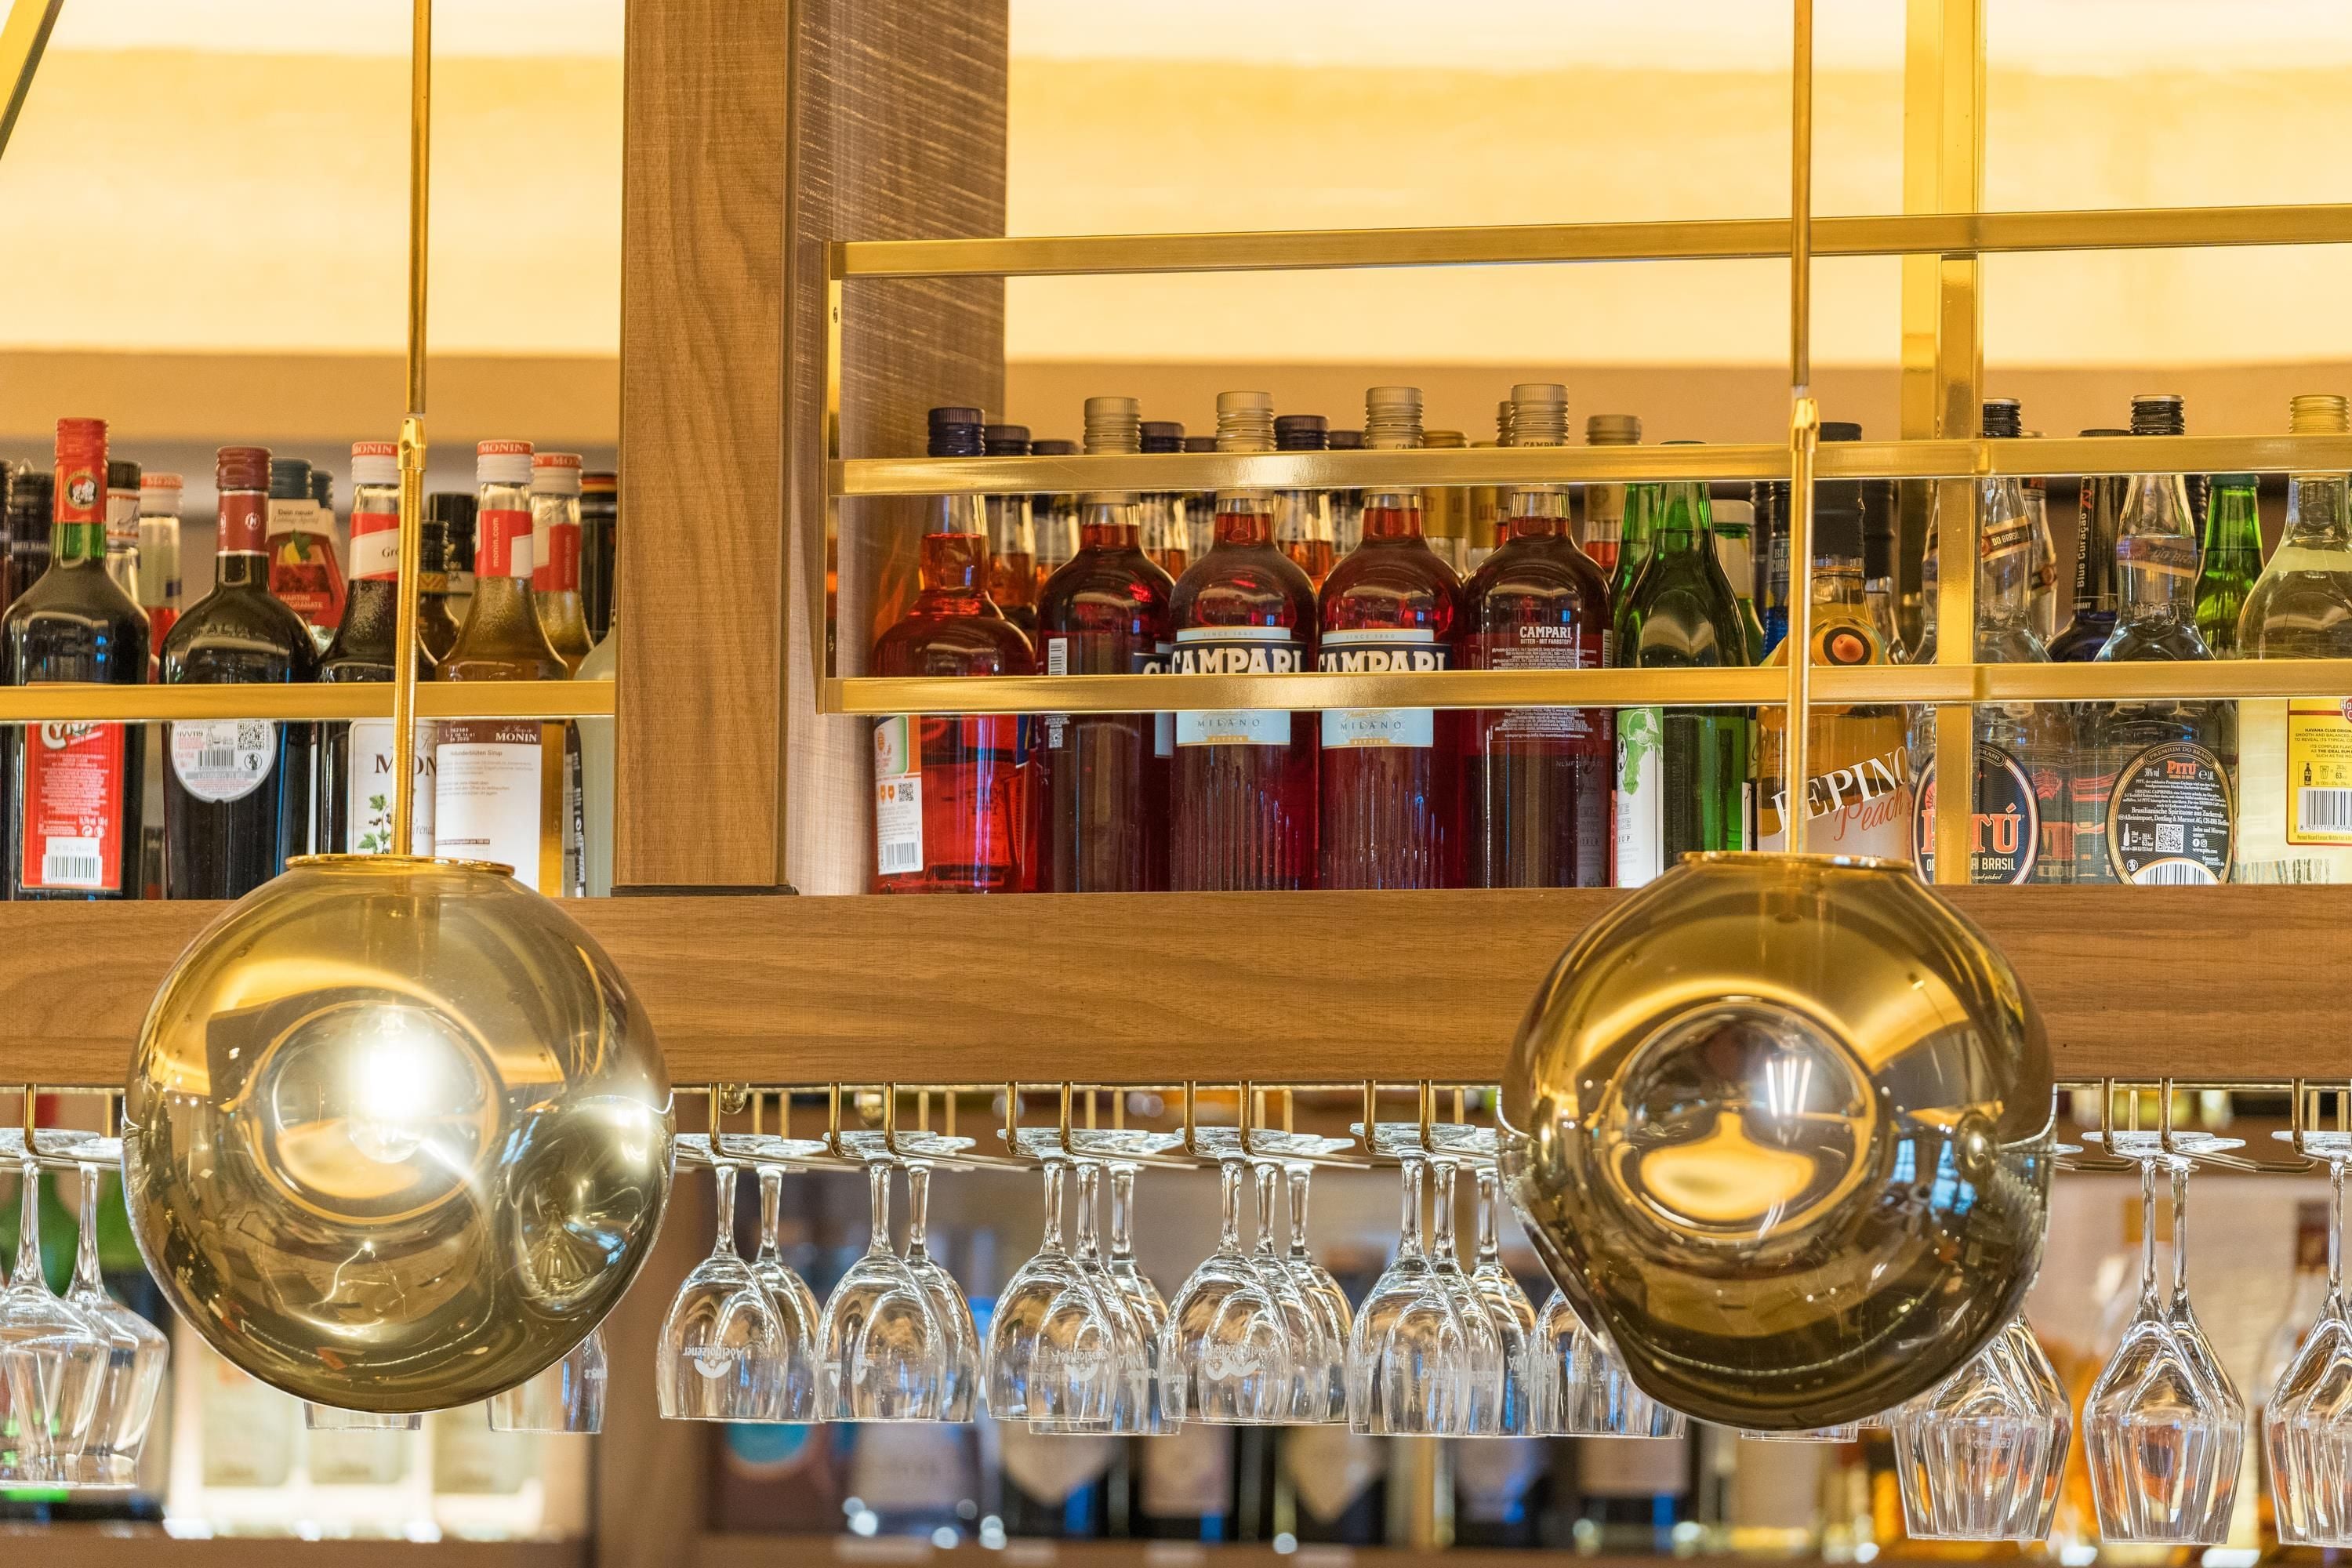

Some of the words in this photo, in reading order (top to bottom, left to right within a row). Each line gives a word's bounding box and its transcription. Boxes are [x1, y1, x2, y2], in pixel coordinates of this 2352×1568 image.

[481, 442, 524, 452] MONIN
[1991, 536, 2002, 546] DO
[2002, 532, 2020, 543] BRASIL
[2077, 562, 2085, 588] Blue
[1519, 626, 1572, 639] CAMPARI
[1197, 718, 1261, 727] MILANO
[1341, 720, 1402, 729] MILANO
[495, 732, 537, 742] MONIN
[2149, 746, 2182, 760] PREMIUM
[2192, 747, 2213, 764] BRASIL
[2167, 760, 2196, 775] PITÚ
[1834, 789, 1904, 841] Peach
[2168, 808, 2194, 817] Spirituose
[2154, 815, 2172, 824] Dettling
[1921, 802, 2022, 855] TÚ
[1981, 858, 2016, 871] BRASIL
[683, 1346, 743, 1362] Adelholzener
